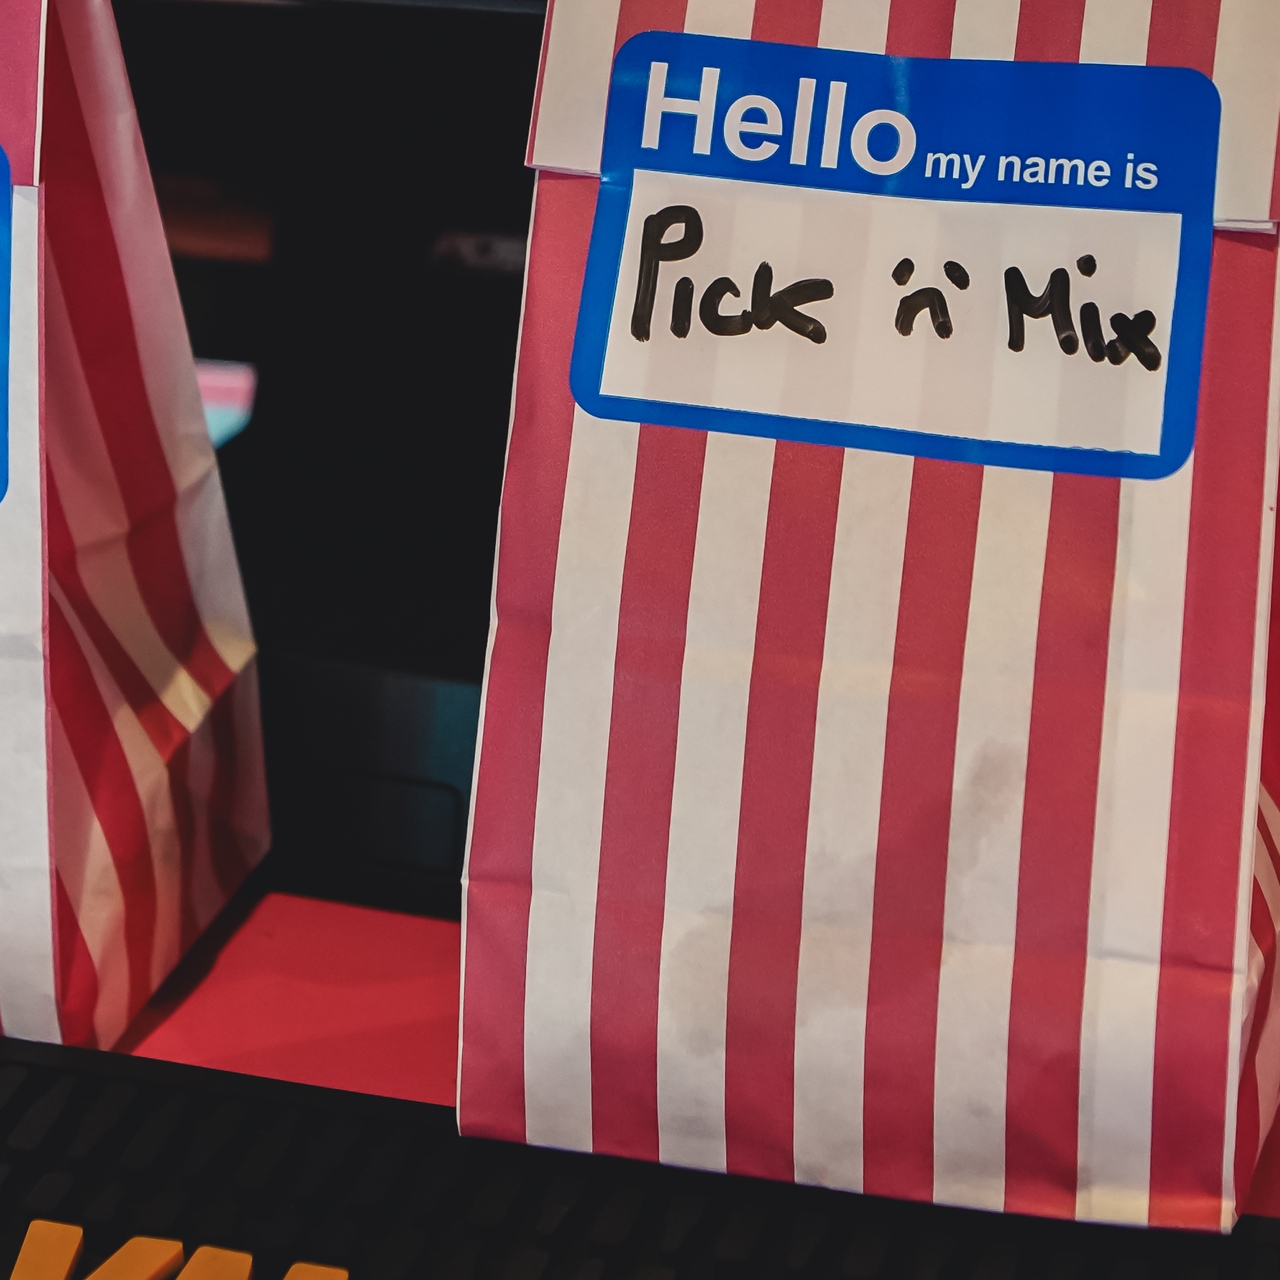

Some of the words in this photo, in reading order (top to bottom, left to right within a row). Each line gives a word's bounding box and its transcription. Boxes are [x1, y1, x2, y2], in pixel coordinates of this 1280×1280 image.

[639, 60, 918, 177] Hello
[924, 150, 983, 189] my
[996, 153, 1111, 188] name
[1123, 152, 1160, 190] is
[631, 204, 835, 345] Pick
[1004, 253, 1163, 372] Mix
